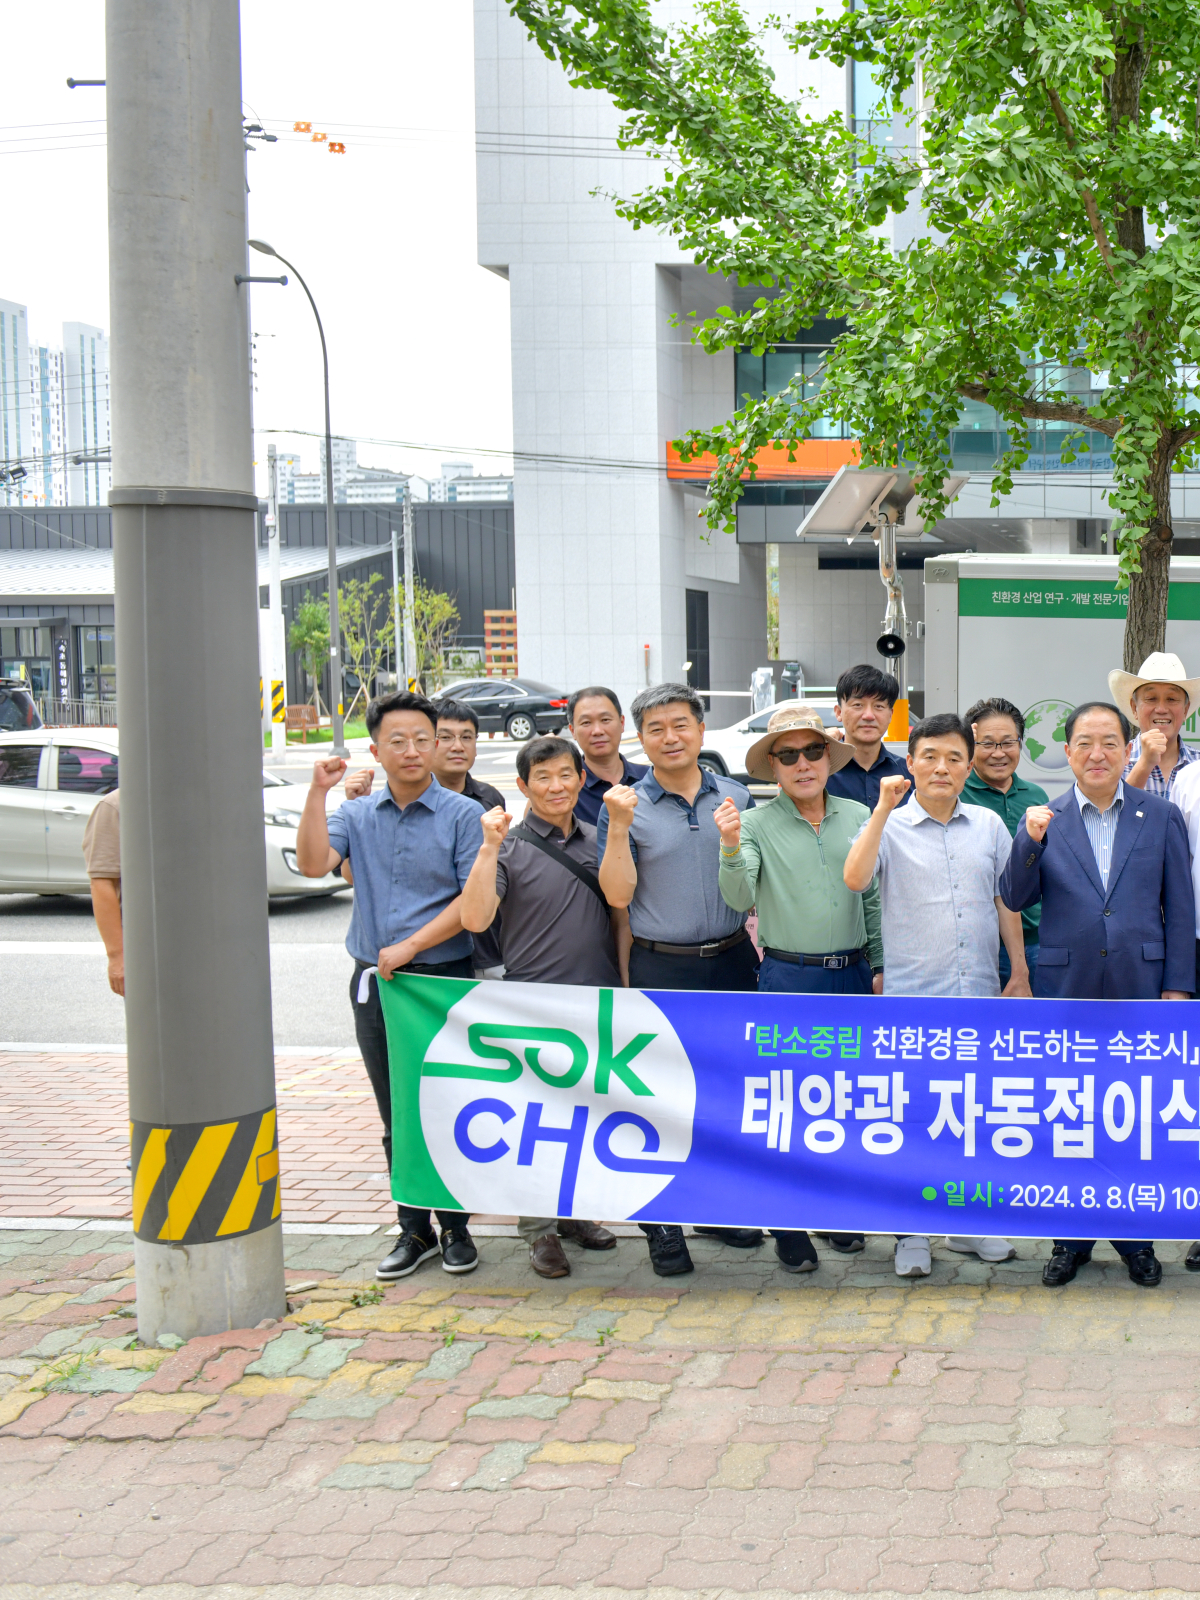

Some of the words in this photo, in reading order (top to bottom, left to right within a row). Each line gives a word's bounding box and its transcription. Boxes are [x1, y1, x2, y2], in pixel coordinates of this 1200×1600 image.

[992, 591, 1021, 604] 친환경
[1023, 591, 1042, 604] 산업
[871, 1025, 981, 1061] 친환경을
[988, 1027, 1099, 1063] 선도하는
[740, 1069, 910, 1155] 태양광
